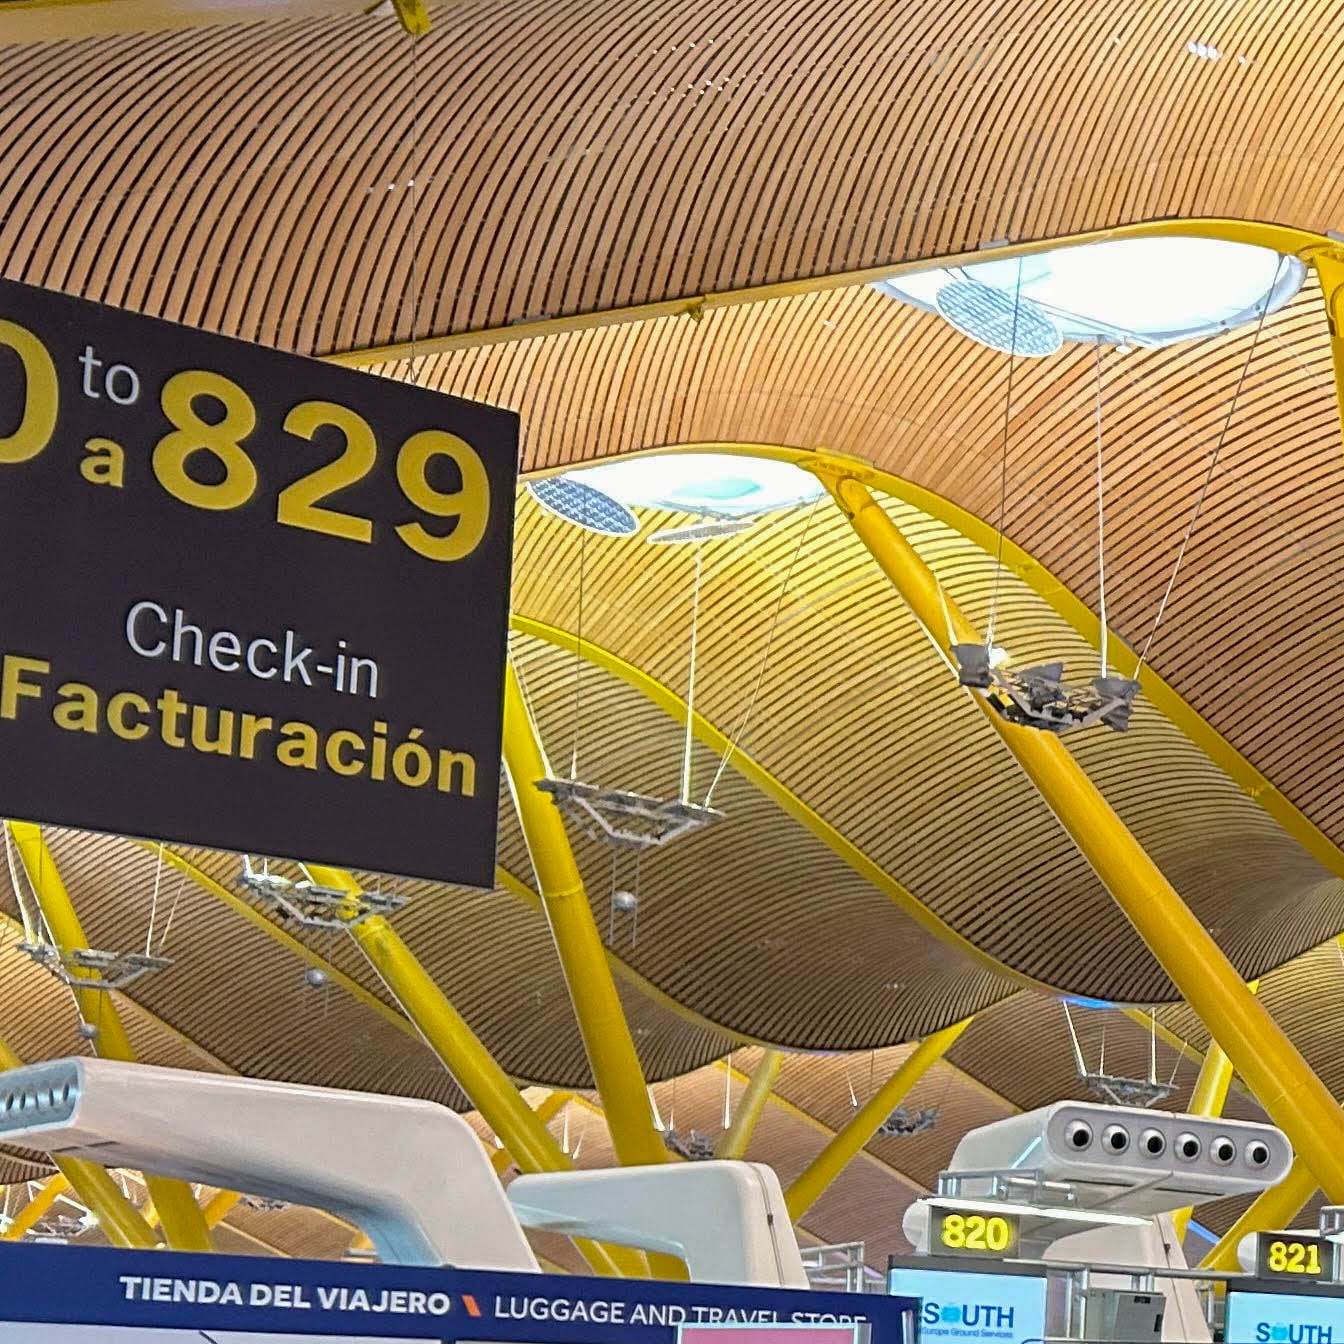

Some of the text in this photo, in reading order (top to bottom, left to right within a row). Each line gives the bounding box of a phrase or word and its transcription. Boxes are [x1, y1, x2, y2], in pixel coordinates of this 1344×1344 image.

[78, 345, 140, 405] to
[152, 370, 491, 562] 829
[80, 436, 126, 488] a
[125, 601, 379, 699] Check-in
[1, 654, 476, 798] Facturación
[942, 1214, 1009, 1251] 820
[1269, 1241, 1321, 1275] 821
[119, 1276, 450, 1316] TIENDA DEL VIAJERO
[494, 1296, 626, 1326] LUGGAGE
[629, 1304, 687, 1327] AND
